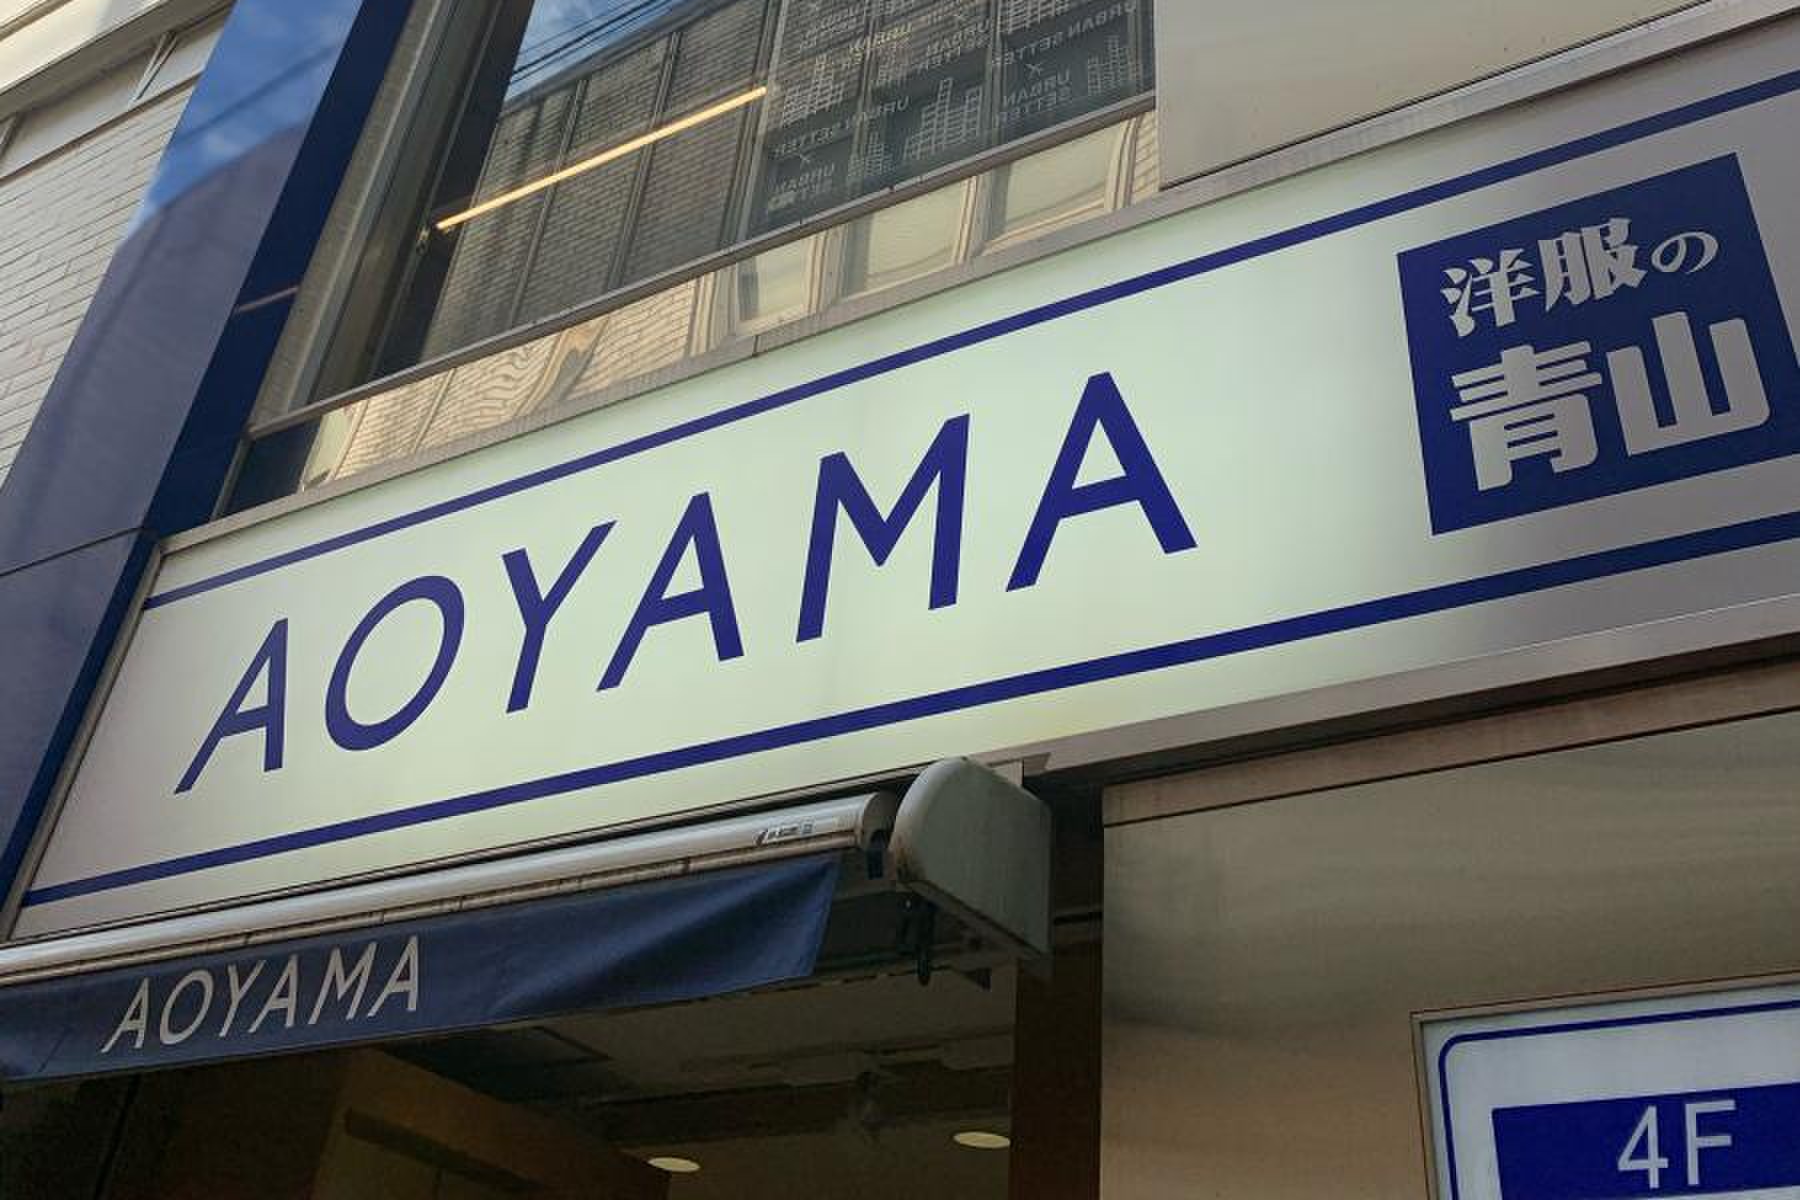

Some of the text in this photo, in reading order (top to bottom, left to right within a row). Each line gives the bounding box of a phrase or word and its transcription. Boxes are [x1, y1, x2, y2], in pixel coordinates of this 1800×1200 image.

[1440, 216, 1720, 338] 洋服の
[1449, 311, 1771, 492] 青山
[173, 370, 1198, 795] AOYAMA
[100, 935, 421, 1055] AOYAMA
[1617, 1098, 1737, 1189] 4F
